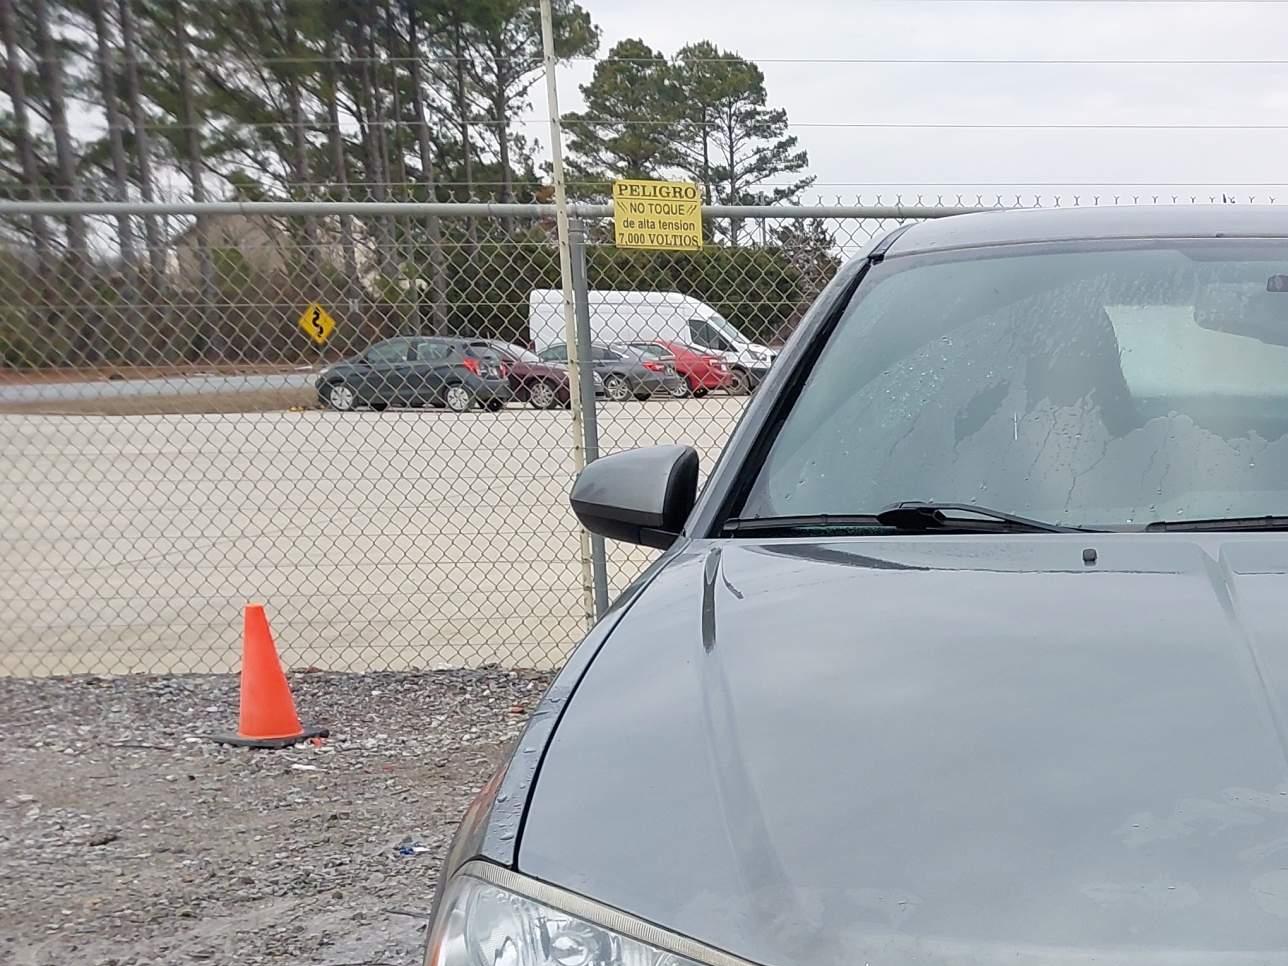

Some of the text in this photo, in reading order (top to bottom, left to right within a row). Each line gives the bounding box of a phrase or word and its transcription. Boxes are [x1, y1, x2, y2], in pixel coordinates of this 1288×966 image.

[617, 184, 697, 199] PELIGRO
[630, 203, 685, 216] NO TOQUE
[623, 218, 695, 231] de alta tension
[619, 233, 699, 247] 7,000 VOLTIOS
